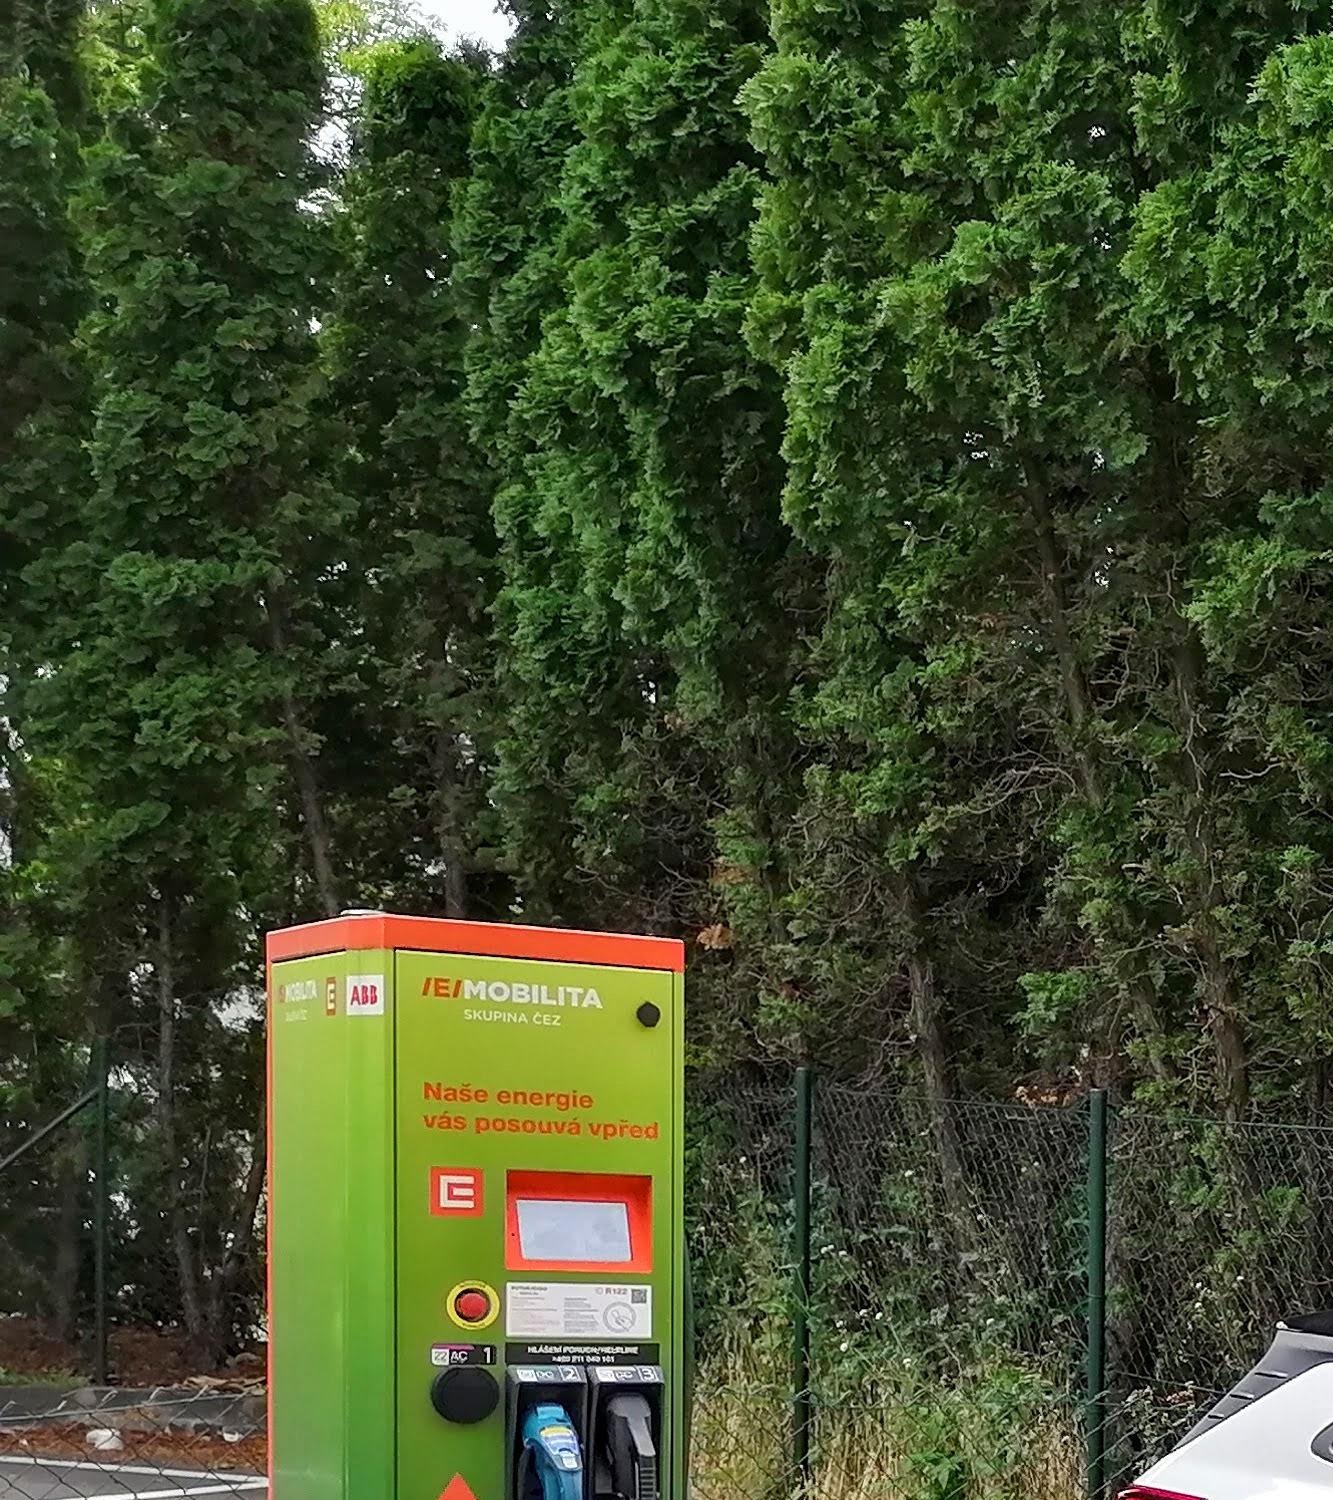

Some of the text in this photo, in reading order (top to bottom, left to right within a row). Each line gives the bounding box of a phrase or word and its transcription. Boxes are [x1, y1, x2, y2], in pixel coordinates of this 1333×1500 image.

[350, 985, 378, 1006] ABB
[463, 1008, 562, 1026] SKUPINA ČEZ
[423, 1082, 594, 1109] Naše energie
[423, 1112, 659, 1140] vás posouvá vpřed
[483, 1347, 491, 1364] 1
